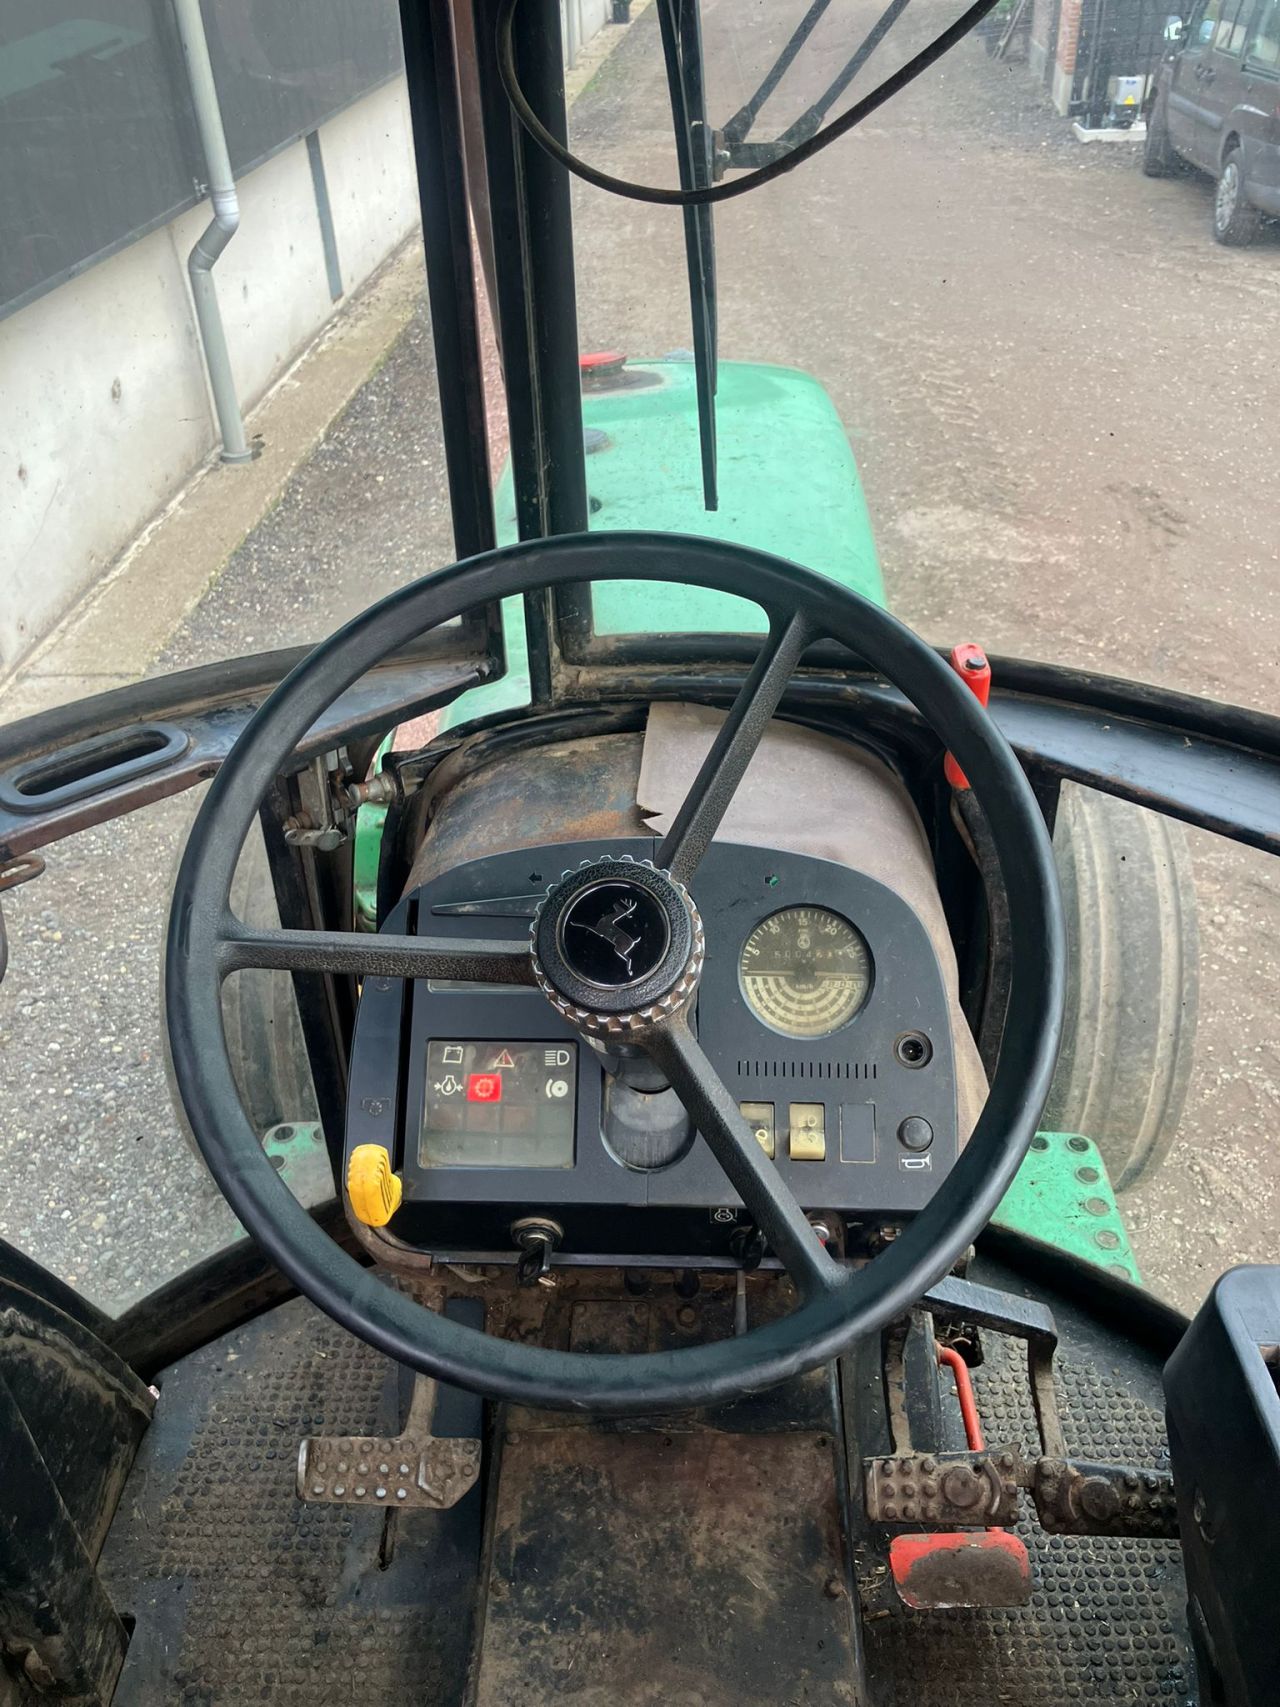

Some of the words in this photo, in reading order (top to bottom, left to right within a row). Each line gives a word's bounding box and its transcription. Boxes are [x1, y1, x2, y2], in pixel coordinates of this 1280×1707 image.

[751, 948, 760, 956] 5
[769, 924, 781, 934] 10
[825, 925, 837, 935] 20
